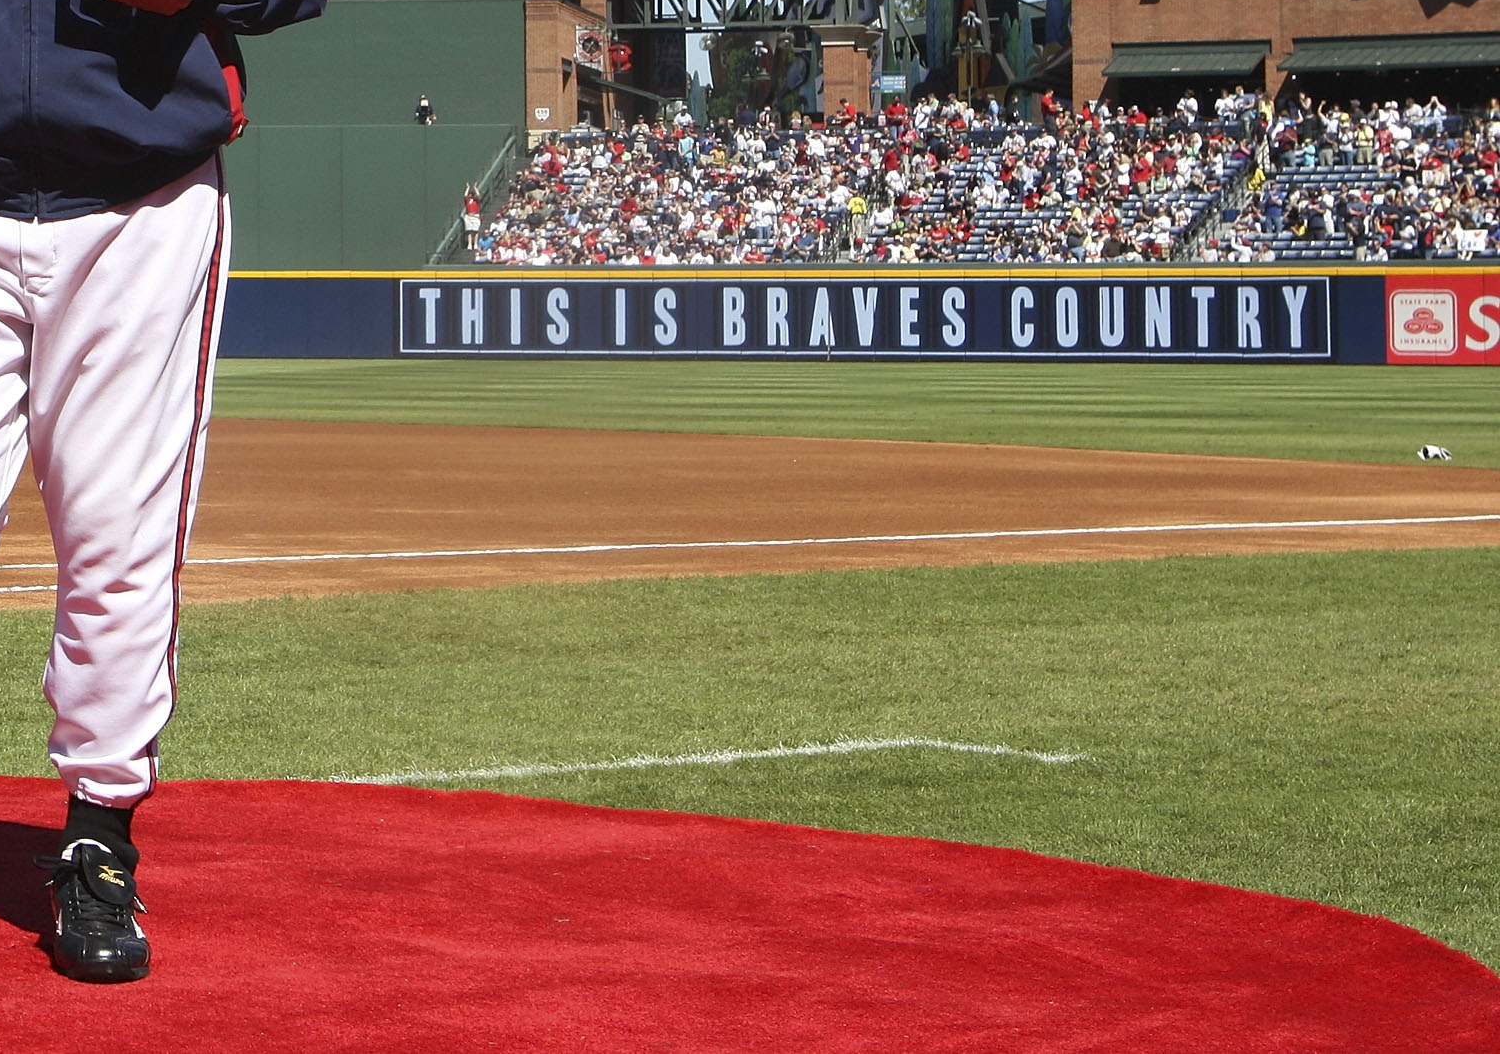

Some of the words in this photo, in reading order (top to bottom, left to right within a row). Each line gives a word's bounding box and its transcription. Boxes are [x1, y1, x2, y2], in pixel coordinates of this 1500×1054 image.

[419, 287, 570, 345] THIS
[615, 287, 678, 346] IS
[723, 286, 966, 347] BRAVES
[1011, 286, 1308, 348] COUNTRY
[1465, 295, 1500, 351] S
